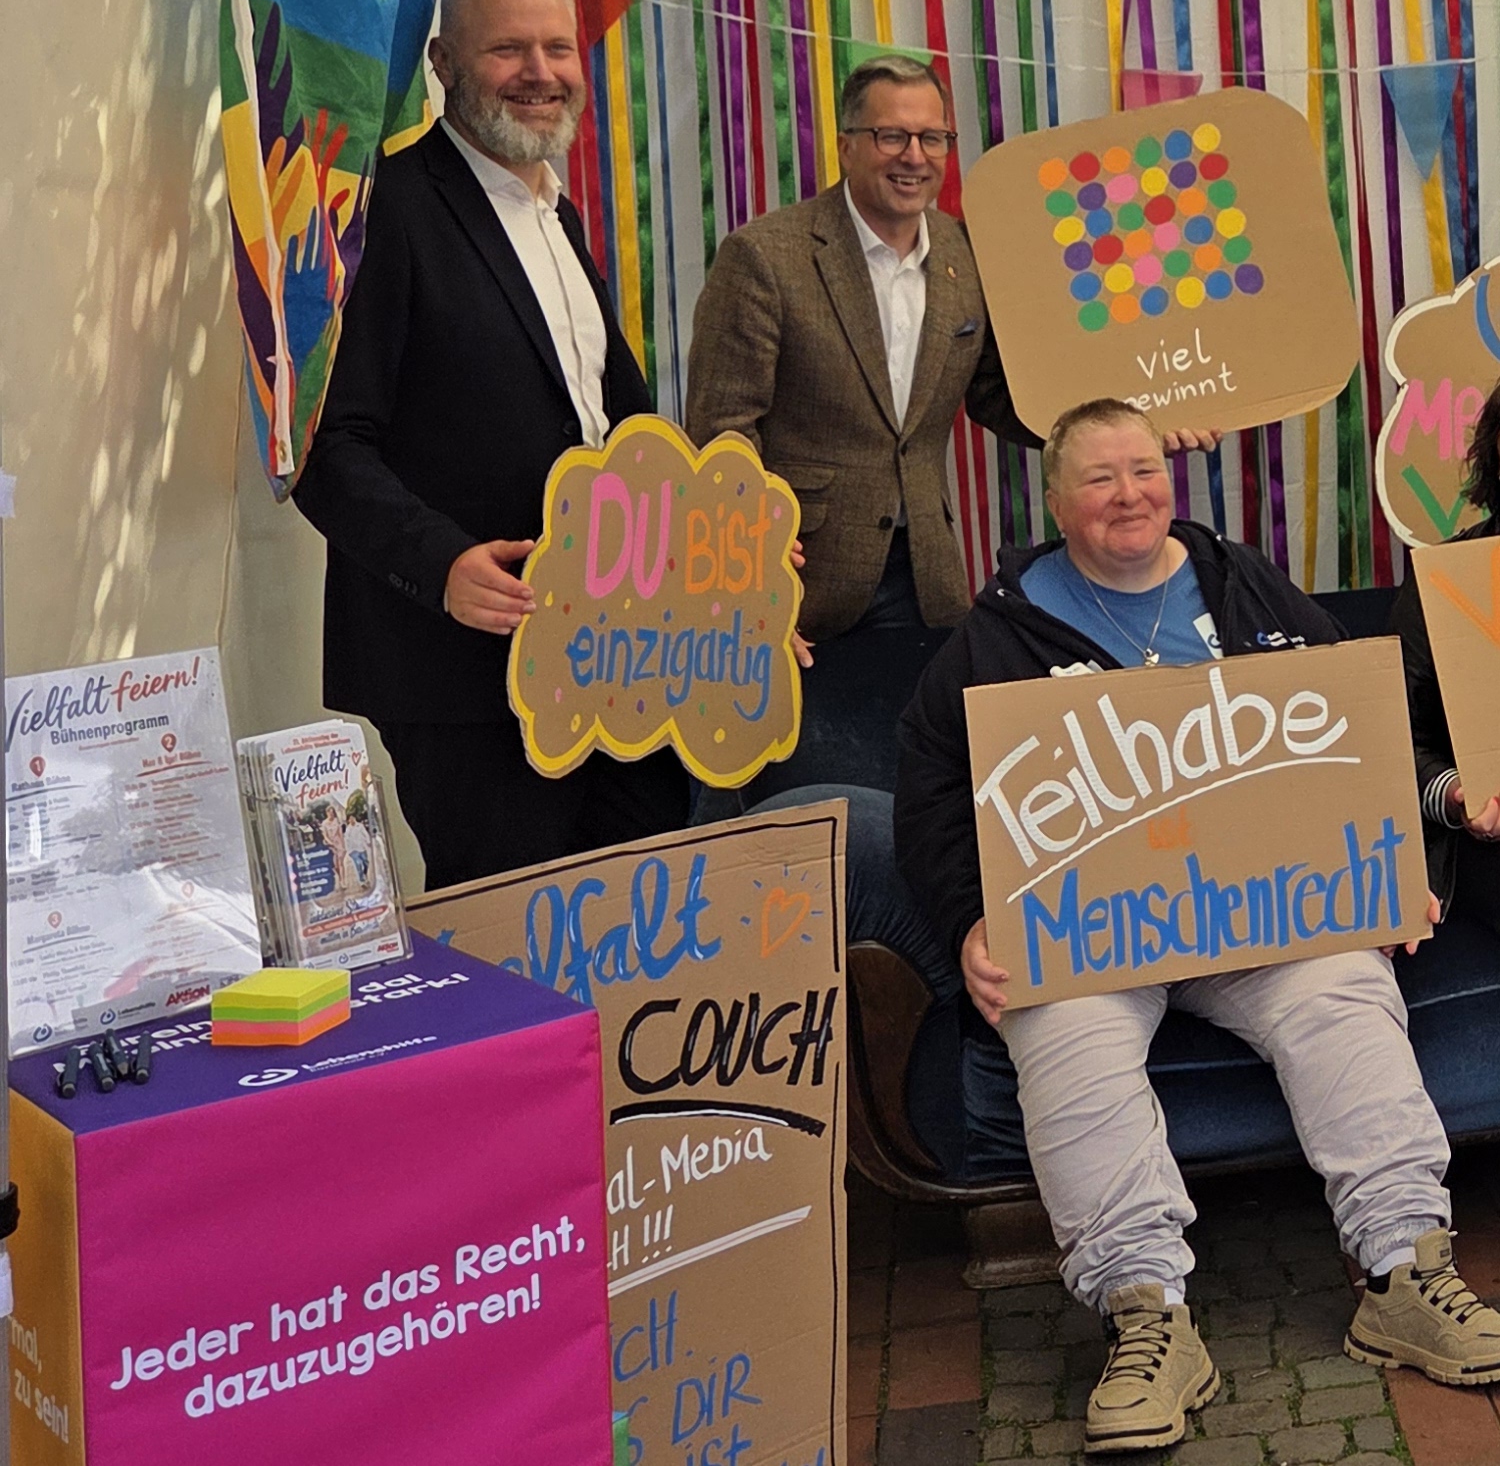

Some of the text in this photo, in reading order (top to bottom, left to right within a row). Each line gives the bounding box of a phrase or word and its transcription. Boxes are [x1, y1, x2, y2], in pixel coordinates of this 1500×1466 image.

[1123, 362, 1238, 412] ewinnt
[585, 472, 672, 600] DU
[110, 656, 200, 712] feiern!
[565, 609, 773, 722] einzigartig
[50, 714, 170, 746] Bühnenprogramm
[275, 749, 346, 792] Vielfalt
[974, 666, 1349, 868] Teilhabe
[296, 769, 349, 809] feiern!
[438, 853, 721, 1009] lfalt
[1022, 816, 1406, 987] Menschenrecht
[301, 1035, 438, 1071] Lebenshilfe
[618, 987, 839, 1095] COUCH
[9, 1316, 42, 1374] mal,
[110, 1215, 586, 1391] Jeder hat das Recht,
[184, 1273, 542, 1418] dazuzugehören!
[15, 1368, 69, 1444] zu sein!
